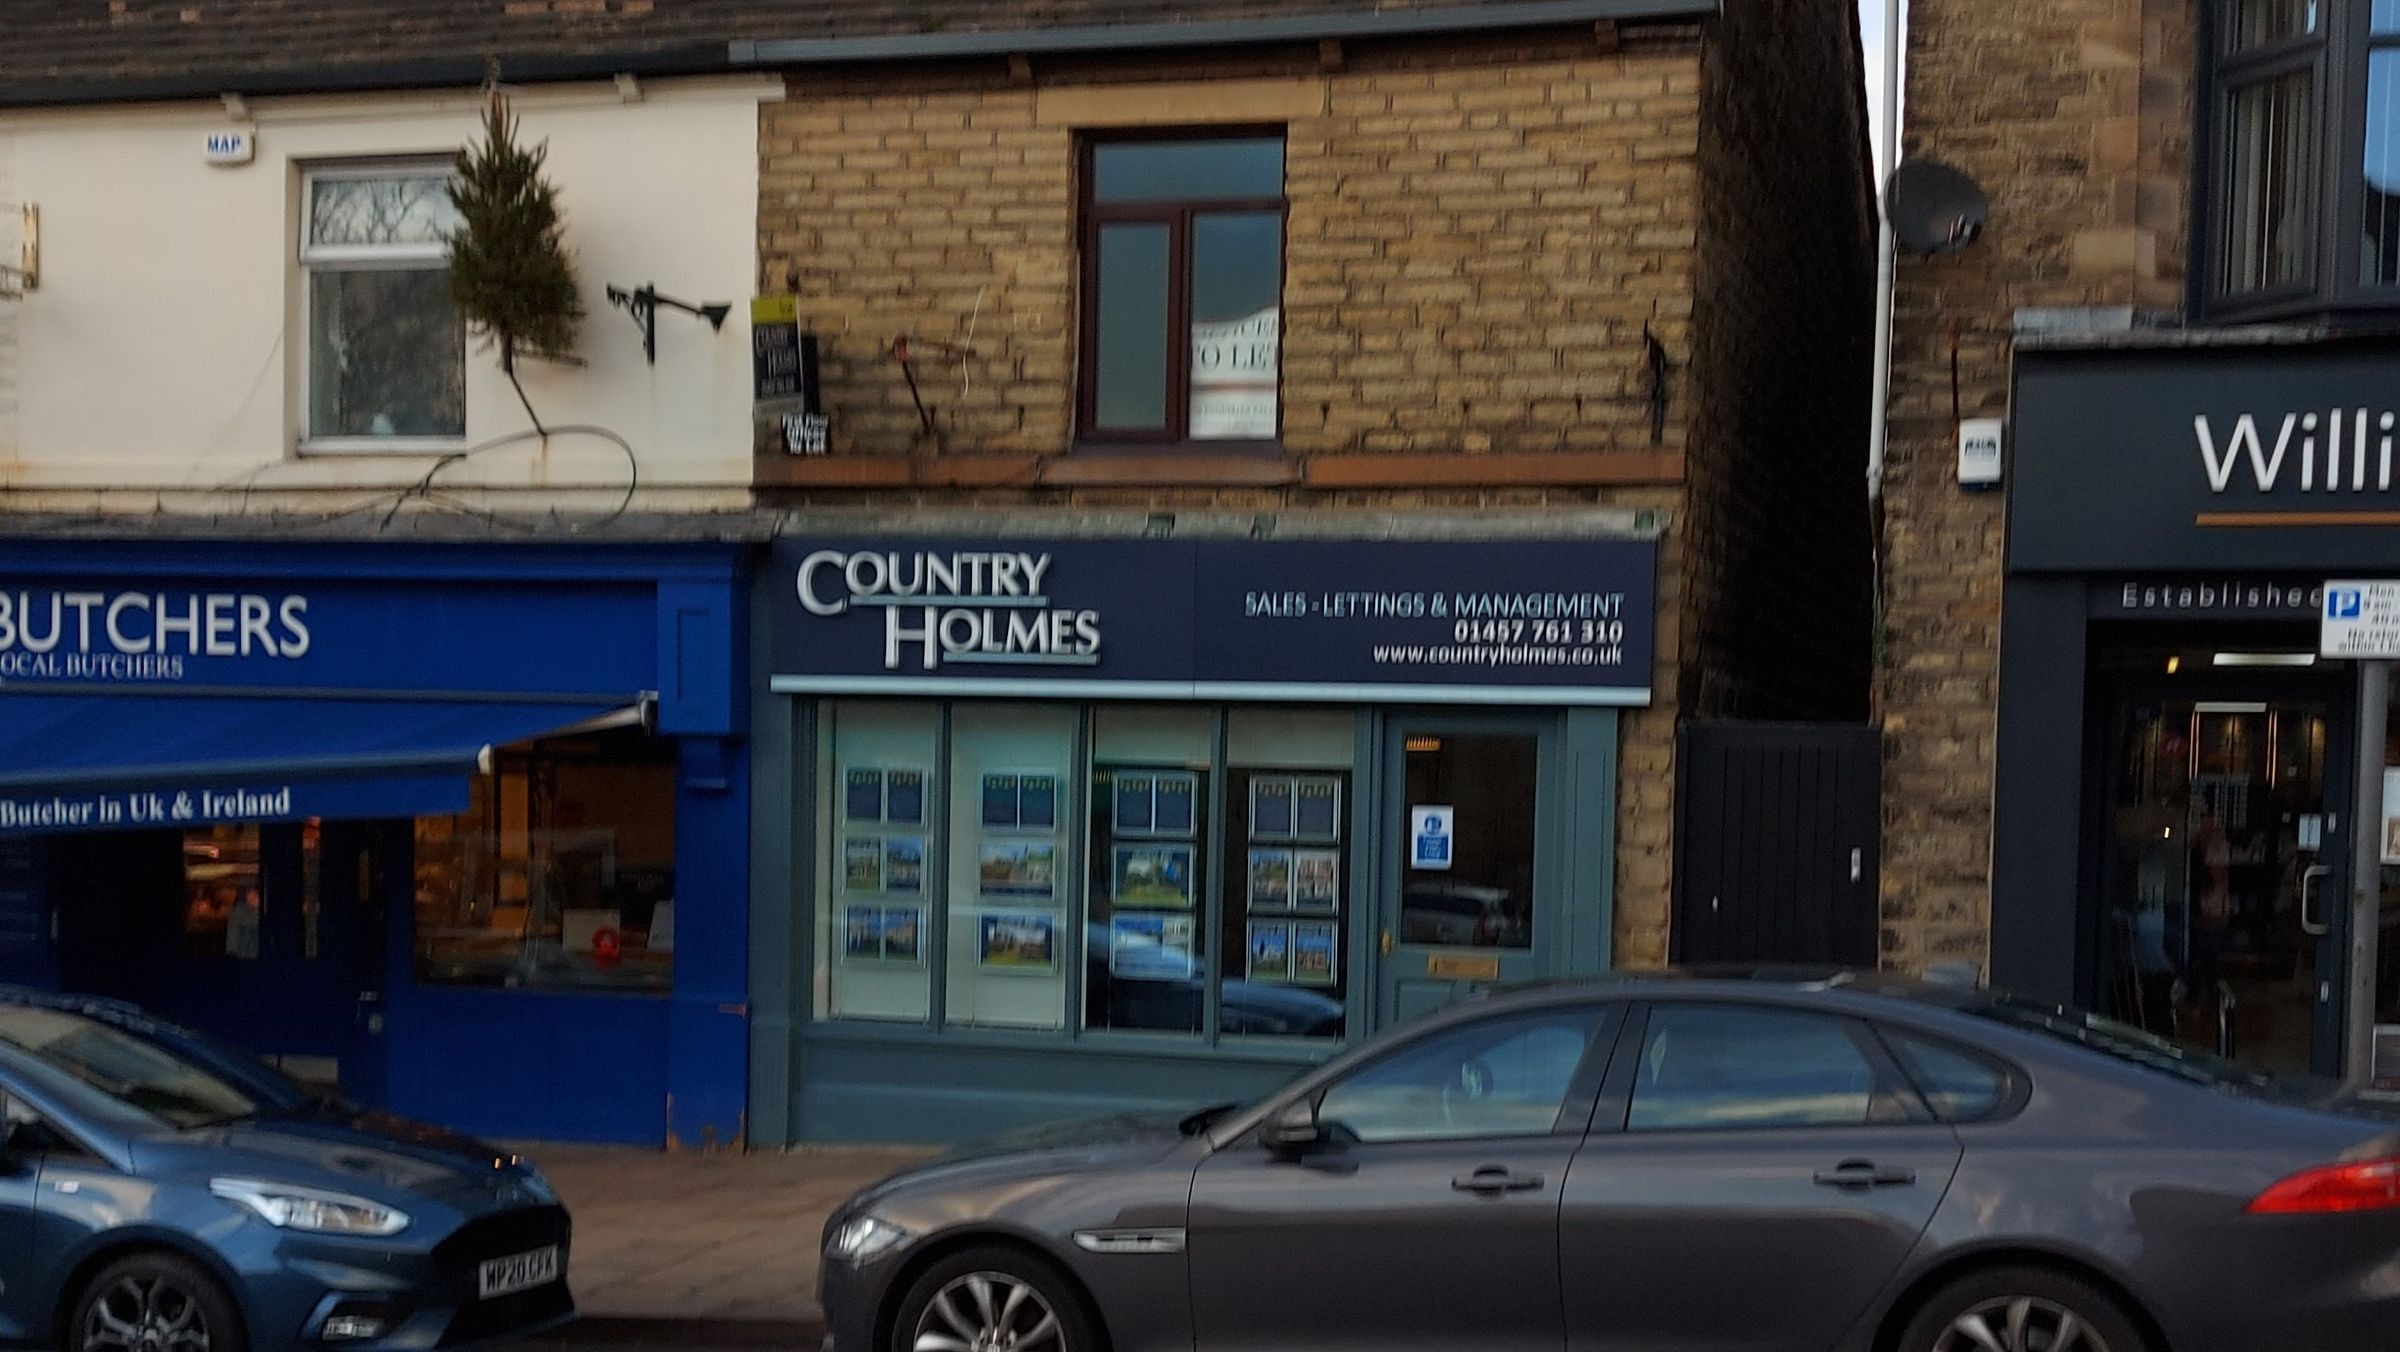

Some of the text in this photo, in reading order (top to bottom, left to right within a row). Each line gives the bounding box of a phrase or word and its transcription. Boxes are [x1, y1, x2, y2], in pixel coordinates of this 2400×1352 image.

[207, 134, 241, 154] MAP
[2194, 407, 2395, 492] Willi
[797, 549, 1050, 617] COUNTRY
[1245, 591, 1307, 617] SALES
[1323, 591, 1425, 618] LETTINGS
[1430, 591, 1448, 618] &
[1454, 592, 1624, 619] MANAGEMENT
[885, 603, 1101, 670] HOLMES
[1454, 618, 1623, 645] 01457 761 310
[66, 651, 184, 680] BUTCHERS
[1373, 642, 1623, 668] www.countryholmes.co.uk
[0, 796, 93, 828] Butcher
[171, 790, 194, 820] &
[202, 785, 290, 818] Ireland
